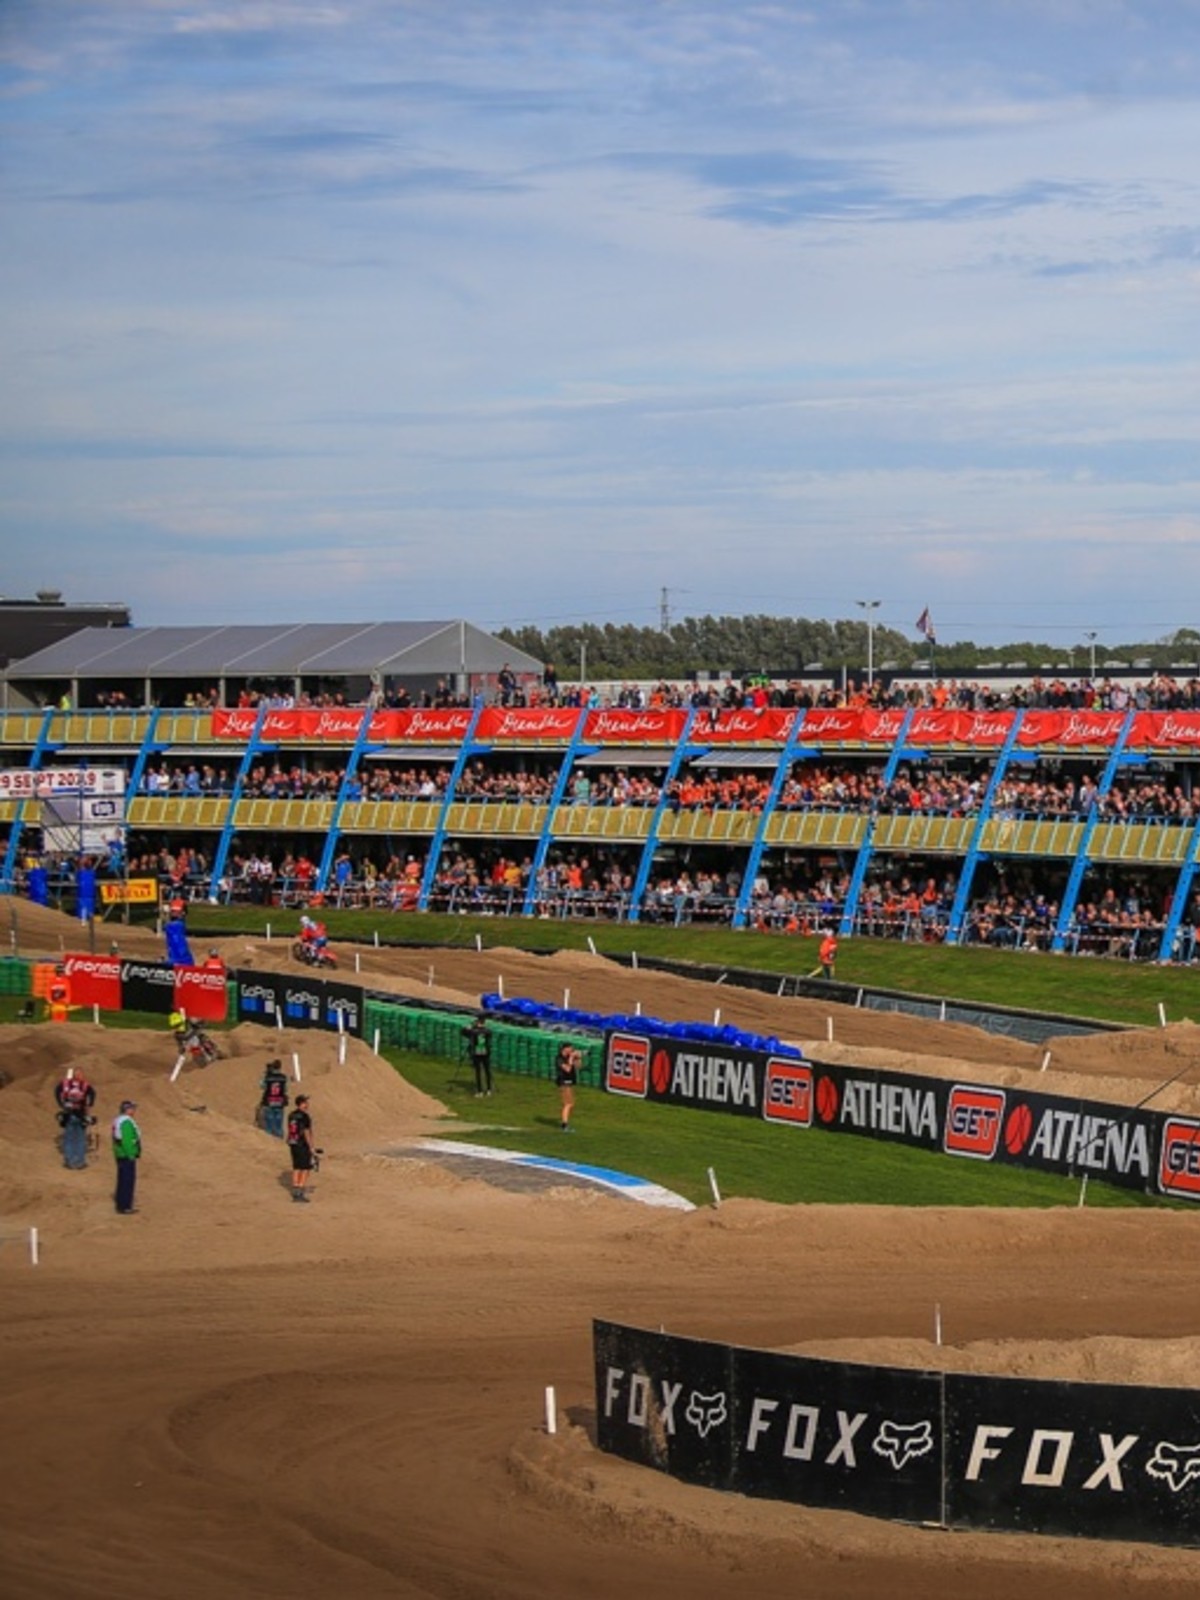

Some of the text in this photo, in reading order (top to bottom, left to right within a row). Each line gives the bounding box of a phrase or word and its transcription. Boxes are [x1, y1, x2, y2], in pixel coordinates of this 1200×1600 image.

[220, 712, 294, 734] Drethe
[314, 712, 386, 735] Drente
[496, 712, 573, 735] Drenthe
[591, 712, 664, 736] Drenthe
[776, 712, 851, 737] Denthe
[869, 712, 947, 737] Drethe
[965, 714, 1040, 739] Drenhe
[241, 984, 275, 999] GoPro
[286, 989, 319, 1006] GoPro
[328, 996, 357, 1013] GoPro
[613, 1052, 644, 1081] GET
[671, 1052, 756, 1107] ATHENA
[770, 1077, 808, 1109] GET
[841, 1080, 938, 1139] ATHENA
[952, 1105, 997, 1139] GET
[1028, 1109, 1149, 1177] ATHENA
[604, 1366, 683, 1436] FOX
[746, 1398, 868, 1468] FOX
[965, 1424, 1139, 1492] FOX
